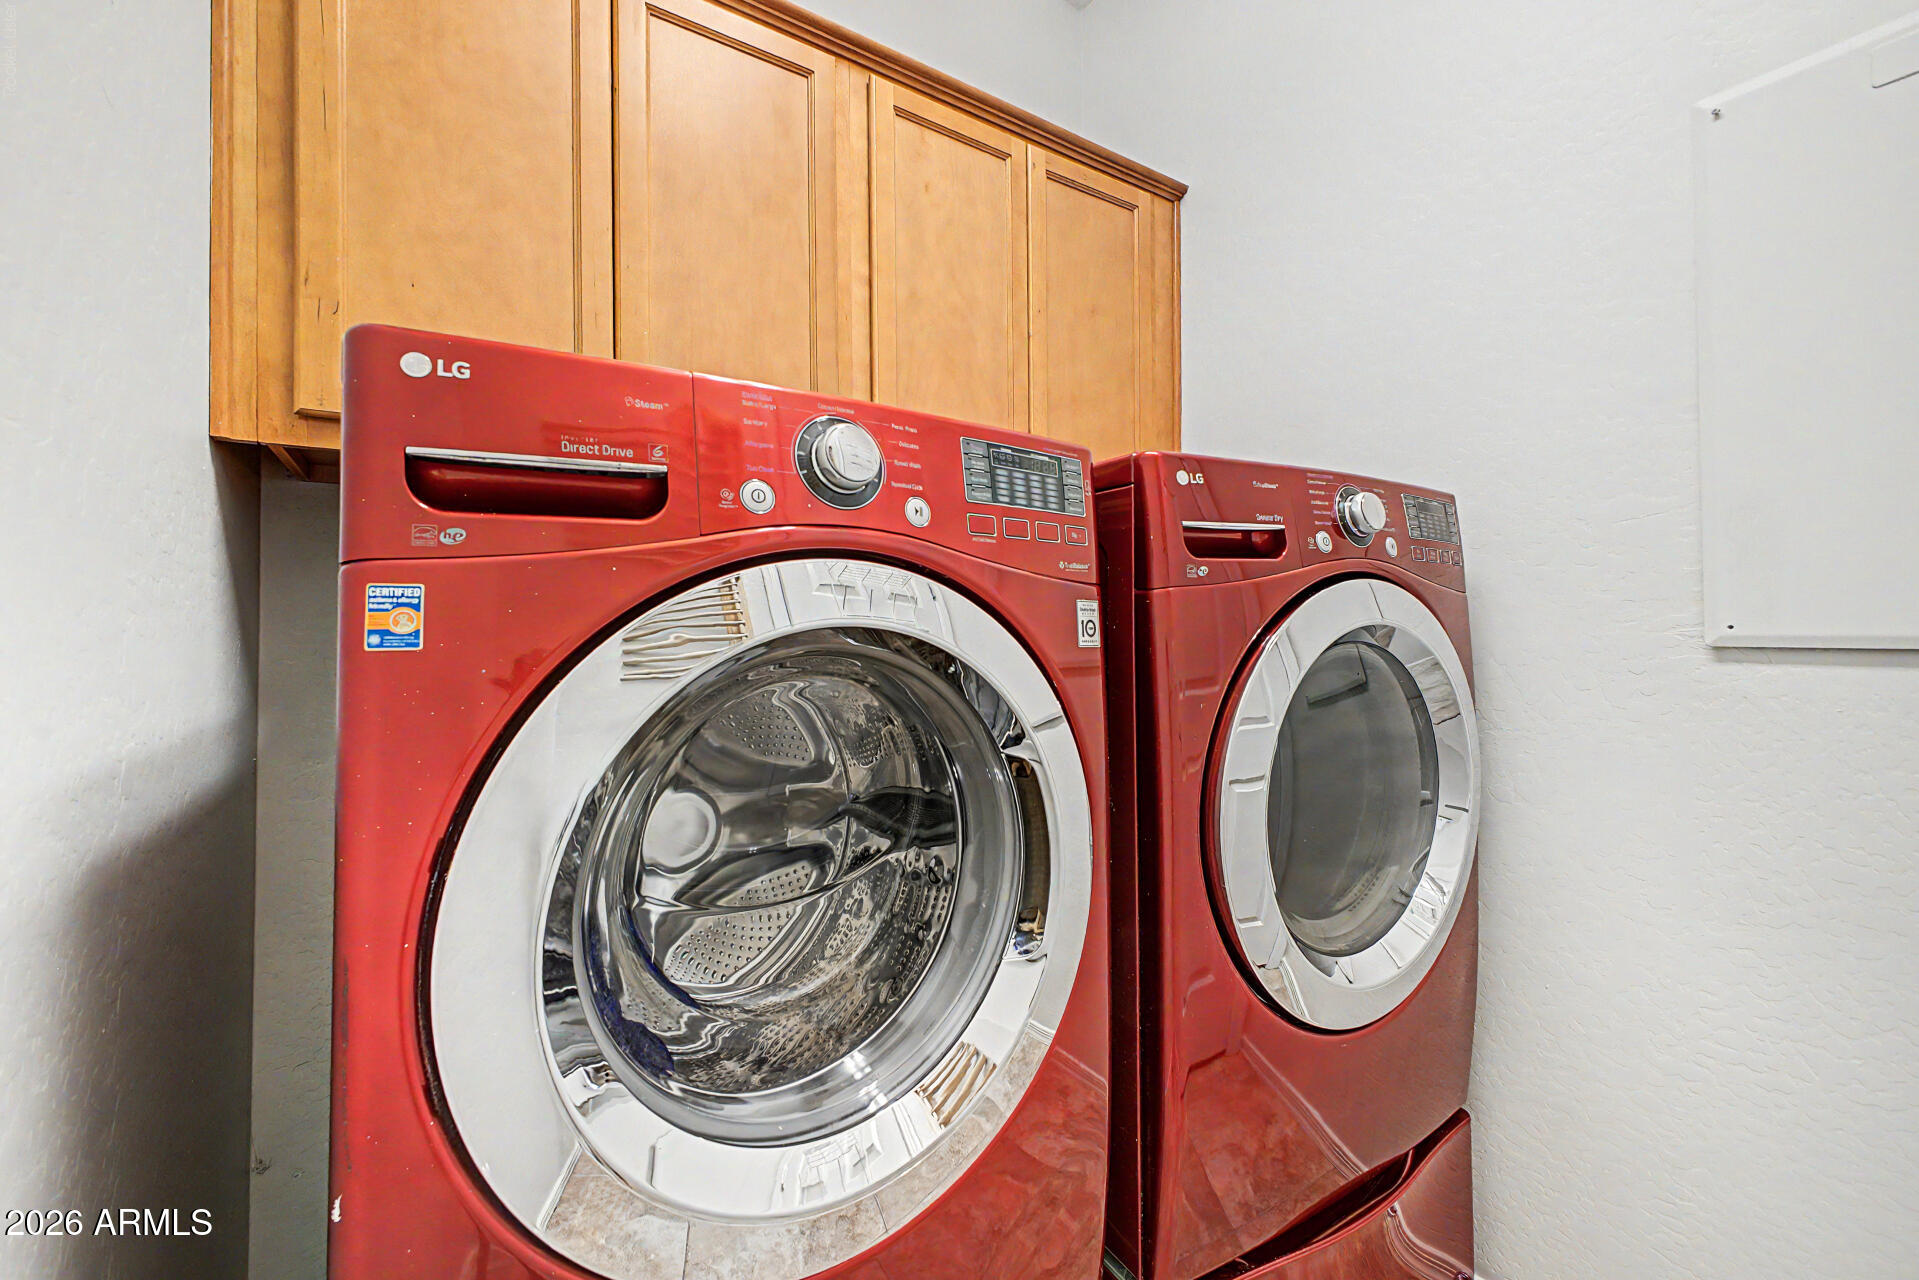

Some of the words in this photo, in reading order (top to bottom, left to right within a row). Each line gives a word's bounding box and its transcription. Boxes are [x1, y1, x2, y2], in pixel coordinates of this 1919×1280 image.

[436, 358, 471, 379] LG
[560, 440, 600, 456] Direct
[601, 444, 634, 458] Drive
[1189, 472, 1204, 484] LG
[368, 586, 421, 597] CERTIFIED
